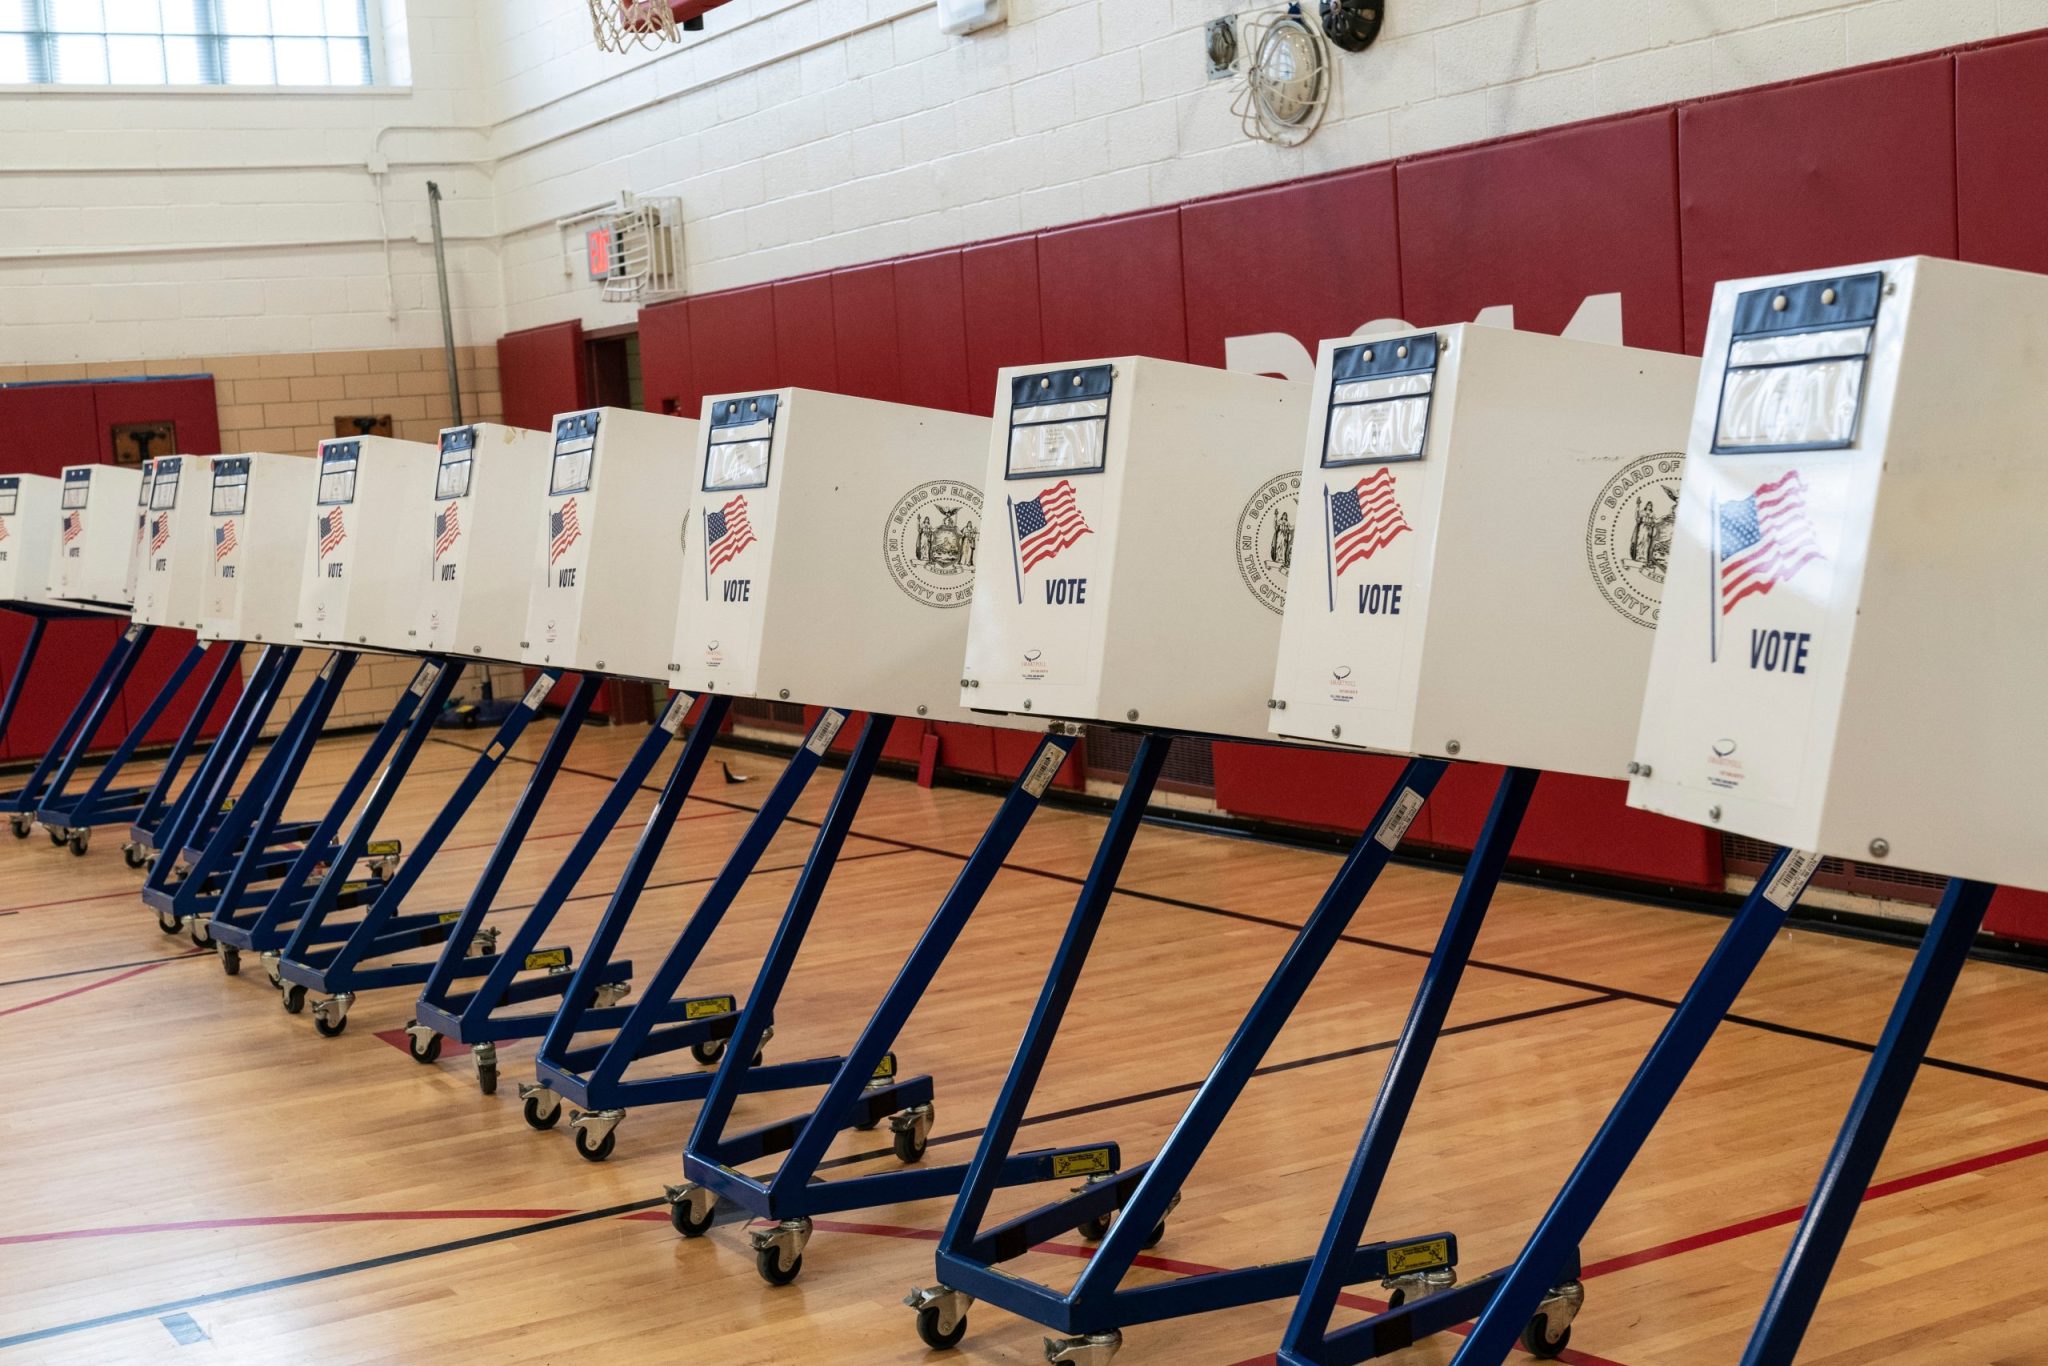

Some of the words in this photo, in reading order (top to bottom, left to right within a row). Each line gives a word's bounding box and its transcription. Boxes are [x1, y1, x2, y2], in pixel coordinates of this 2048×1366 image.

[1604, 464, 1654, 509] BOARD
[1658, 460, 1681, 474] OF
[893, 490, 928, 525] BOARD
[930, 485, 947, 496] OF
[950, 486, 984, 510] ELECT
[1249, 481, 1288, 520] BOARD
[889, 538, 899, 552] IN
[1242, 535, 1252, 551] IN
[1594, 527, 1607, 546] IN
[223, 565, 236, 579] VOTE
[327, 562, 343, 578] VOTE
[441, 563, 457, 581] VOTE
[558, 567, 577, 588] VOTE
[891, 554, 908, 579] THE
[1244, 554, 1261, 583] THE
[1596, 550, 1617, 585] THE
[723, 579, 751, 603] VOTE
[906, 579, 934, 600] CITY
[935, 592, 952, 603] OF
[1045, 578, 1087, 606] VOTE
[1358, 584, 1403, 615] VOTE
[1614, 586, 1650, 616] CITY
[1750, 628, 1812, 675] VOTE
